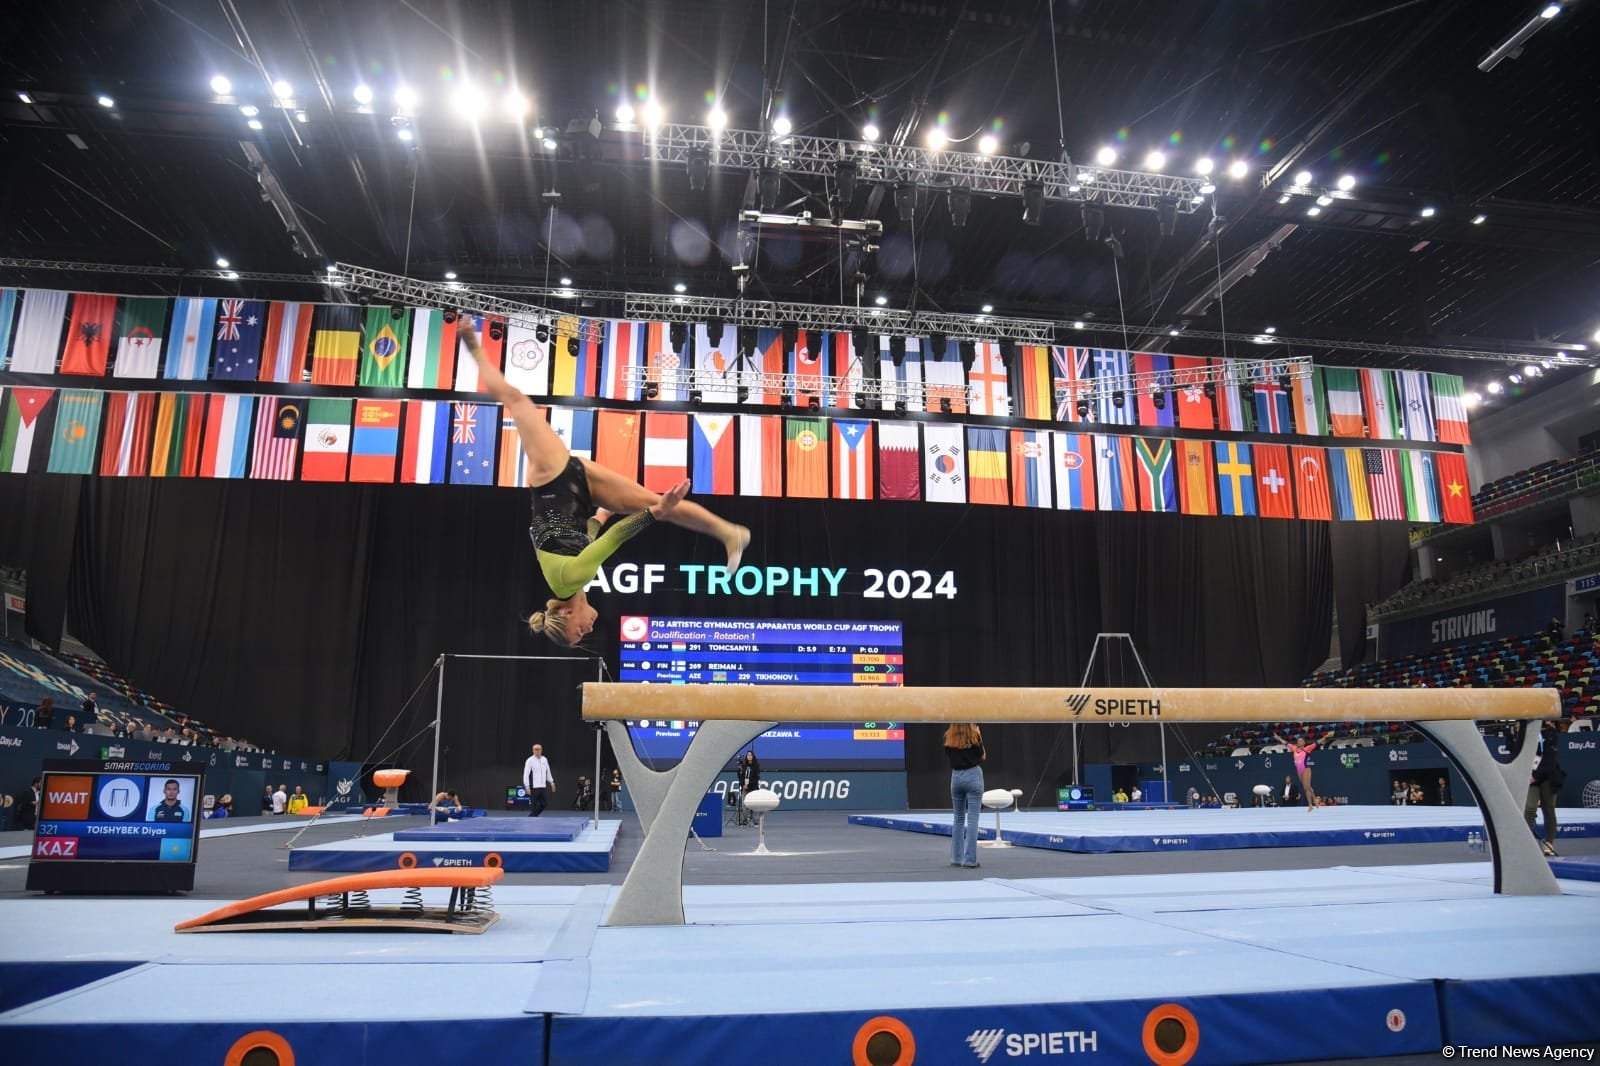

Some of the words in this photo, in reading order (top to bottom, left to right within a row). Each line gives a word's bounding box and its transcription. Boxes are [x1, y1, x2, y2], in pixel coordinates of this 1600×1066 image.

[584, 562, 665, 594] AGF
[679, 564, 847, 597] TROPHY
[863, 568, 957, 599] 2024
[651, 620, 665, 628] FIG
[666, 620, 702, 629] ARTISTIC
[703, 621, 755, 631] GYMNASTICS
[756, 622, 802, 631] APPARATUS
[803, 623, 833, 632] WORLD
[834, 624, 850, 632] CUP
[851, 624, 868, 633] AGF
[869, 624, 900, 633] TROPHY
[1431, 608, 1496, 643] STRIVING
[651, 630, 706, 640] Qualification
[713, 631, 750, 641] Rotation
[709, 644, 751, 652] TOMCSANYI
[756, 673, 793, 681] TIKHONOV
[1095, 699, 1161, 716] SPIETH
[1568, 741, 1596, 750] Day.Az
[104, 762, 171, 771] SMARTSCORING
[49, 791, 89, 805] WAIT
[39, 824, 58, 835] 321
[87, 825, 139, 835] TOISHYBEK
[141, 827, 167, 836] Diyas
[37, 841, 75, 856] KAZ
[1006, 1031, 1097, 1057] SPIETH
